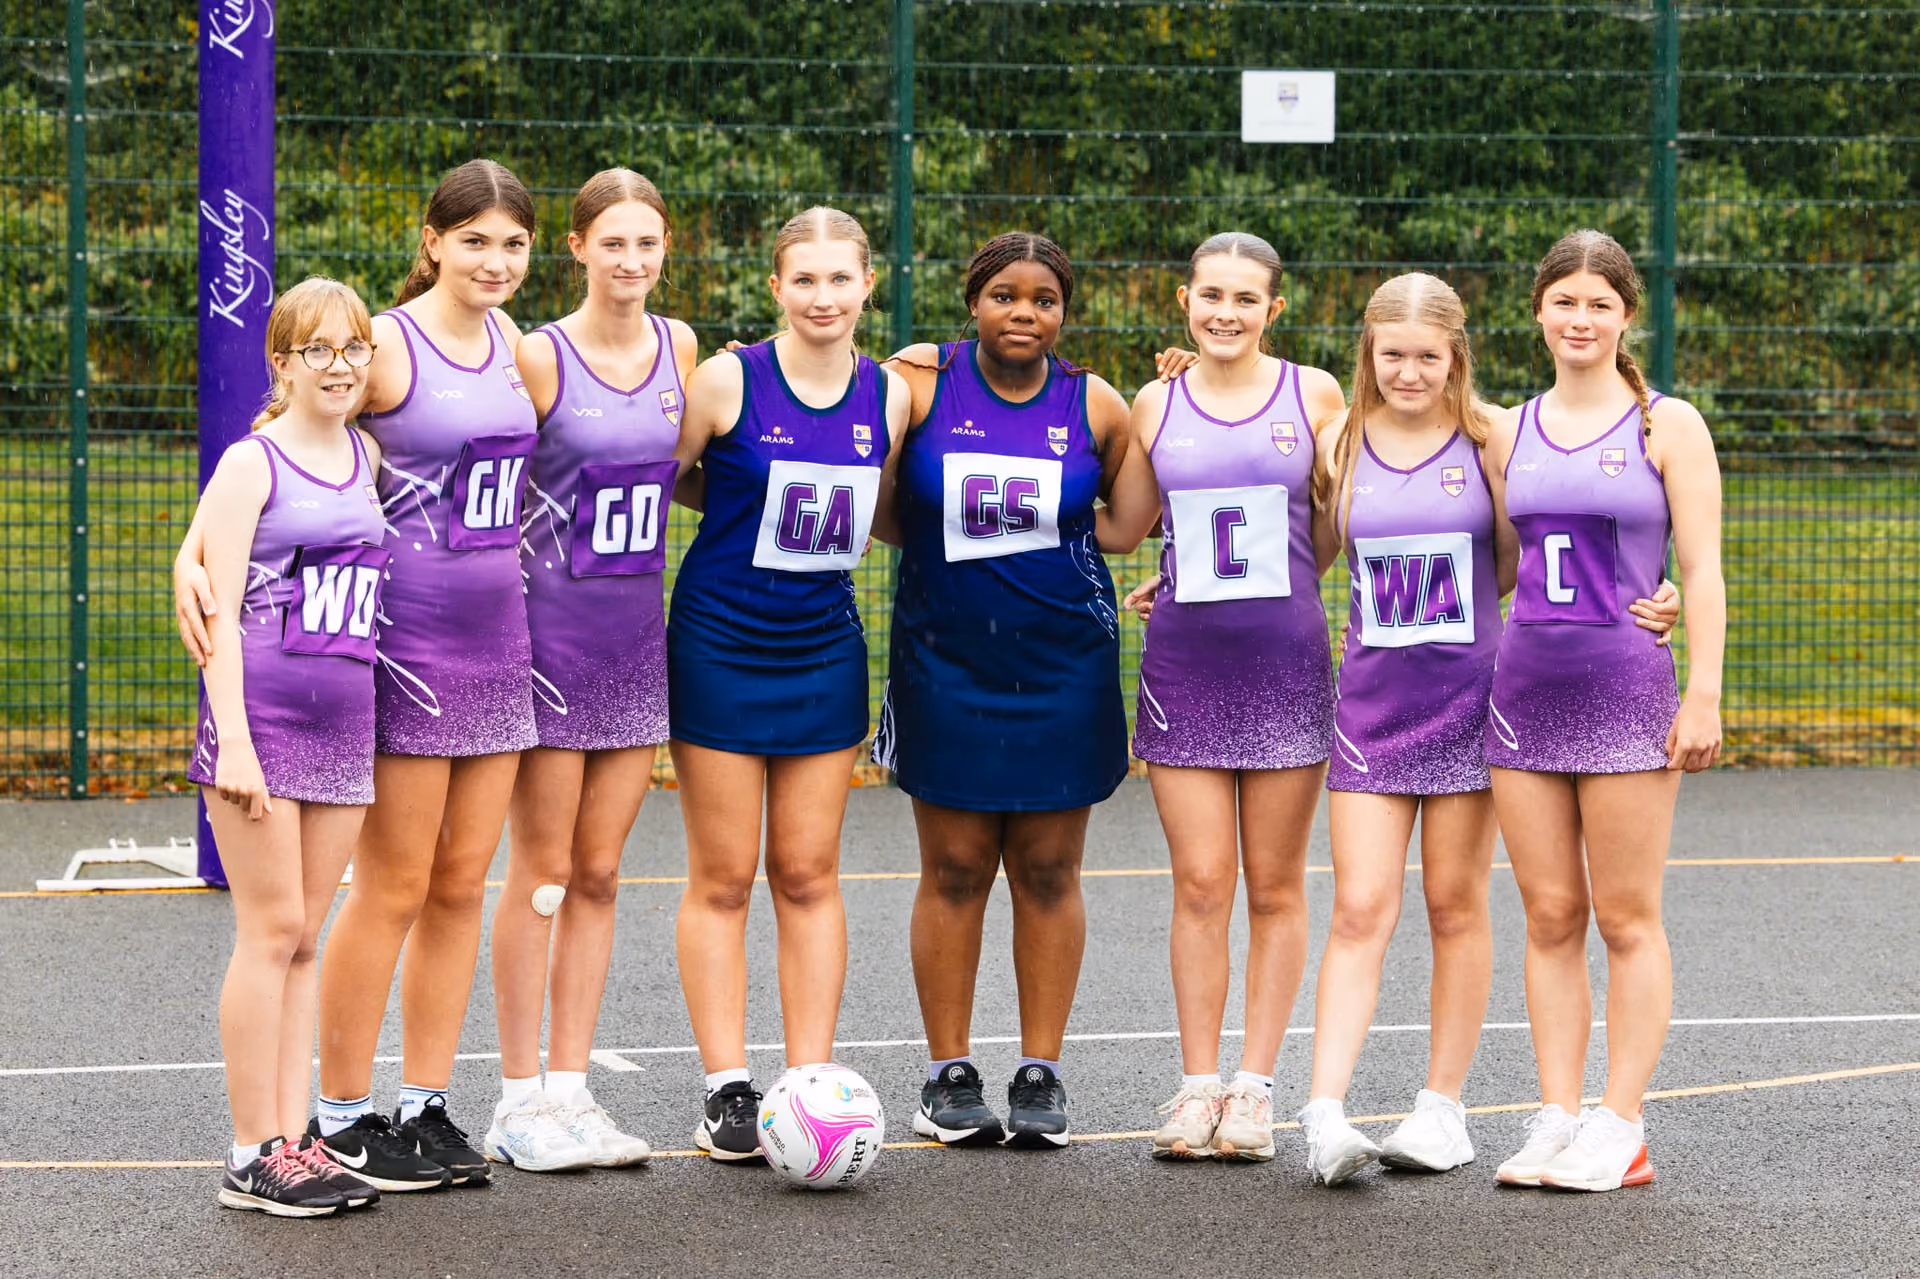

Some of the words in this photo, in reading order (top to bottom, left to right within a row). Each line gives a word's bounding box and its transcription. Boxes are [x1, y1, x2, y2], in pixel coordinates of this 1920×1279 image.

[200, 188, 274, 328] Kingsley
[462, 455, 527, 531] GK
[590, 481, 663, 557] GD
[775, 482, 855, 556] GA
[961, 474, 1040, 540] GS
[1211, 506, 1249, 580] C
[1542, 531, 1579, 606] C
[300, 563, 381, 640] WD
[1364, 553, 1466, 628] WA
